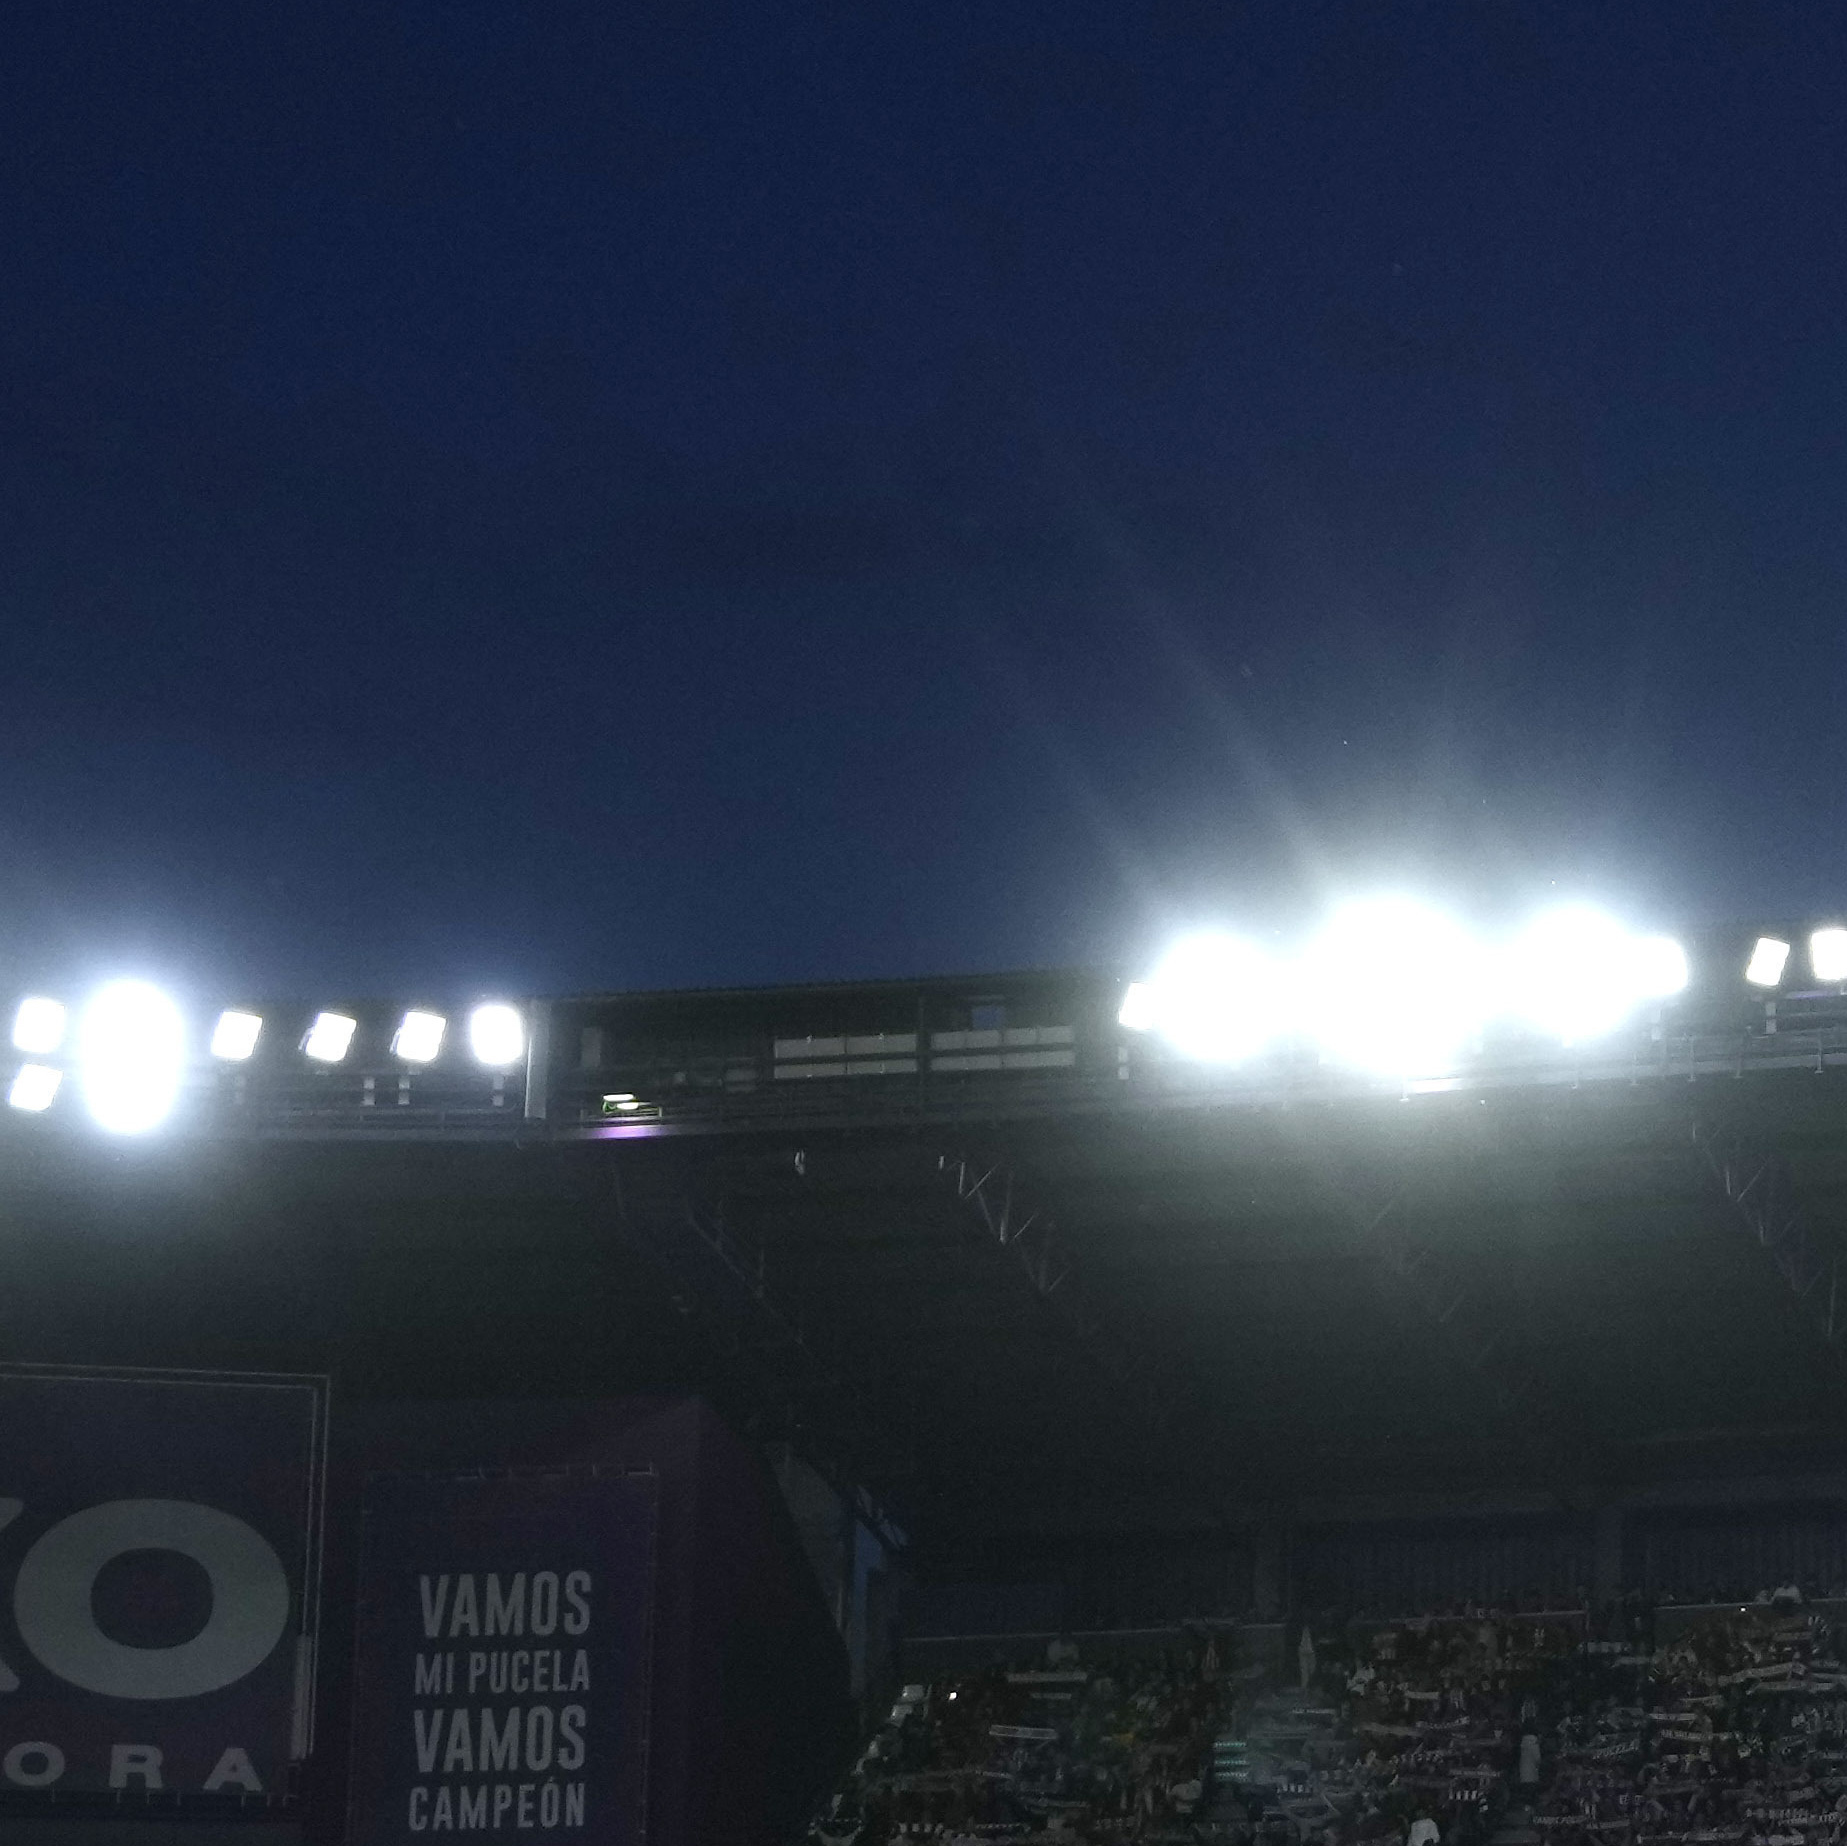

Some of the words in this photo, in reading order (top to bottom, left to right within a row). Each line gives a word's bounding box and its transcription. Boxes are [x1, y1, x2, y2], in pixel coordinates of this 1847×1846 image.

[0, 1498, 289, 1699] O
[419, 1570, 591, 1638] VAMOS
[415, 1653, 453, 1695] MI
[469, 1650, 590, 1693] PUCELA
[413, 1704, 586, 1772] VAMOS
[409, 1777, 586, 1831] CAMPEÓN
